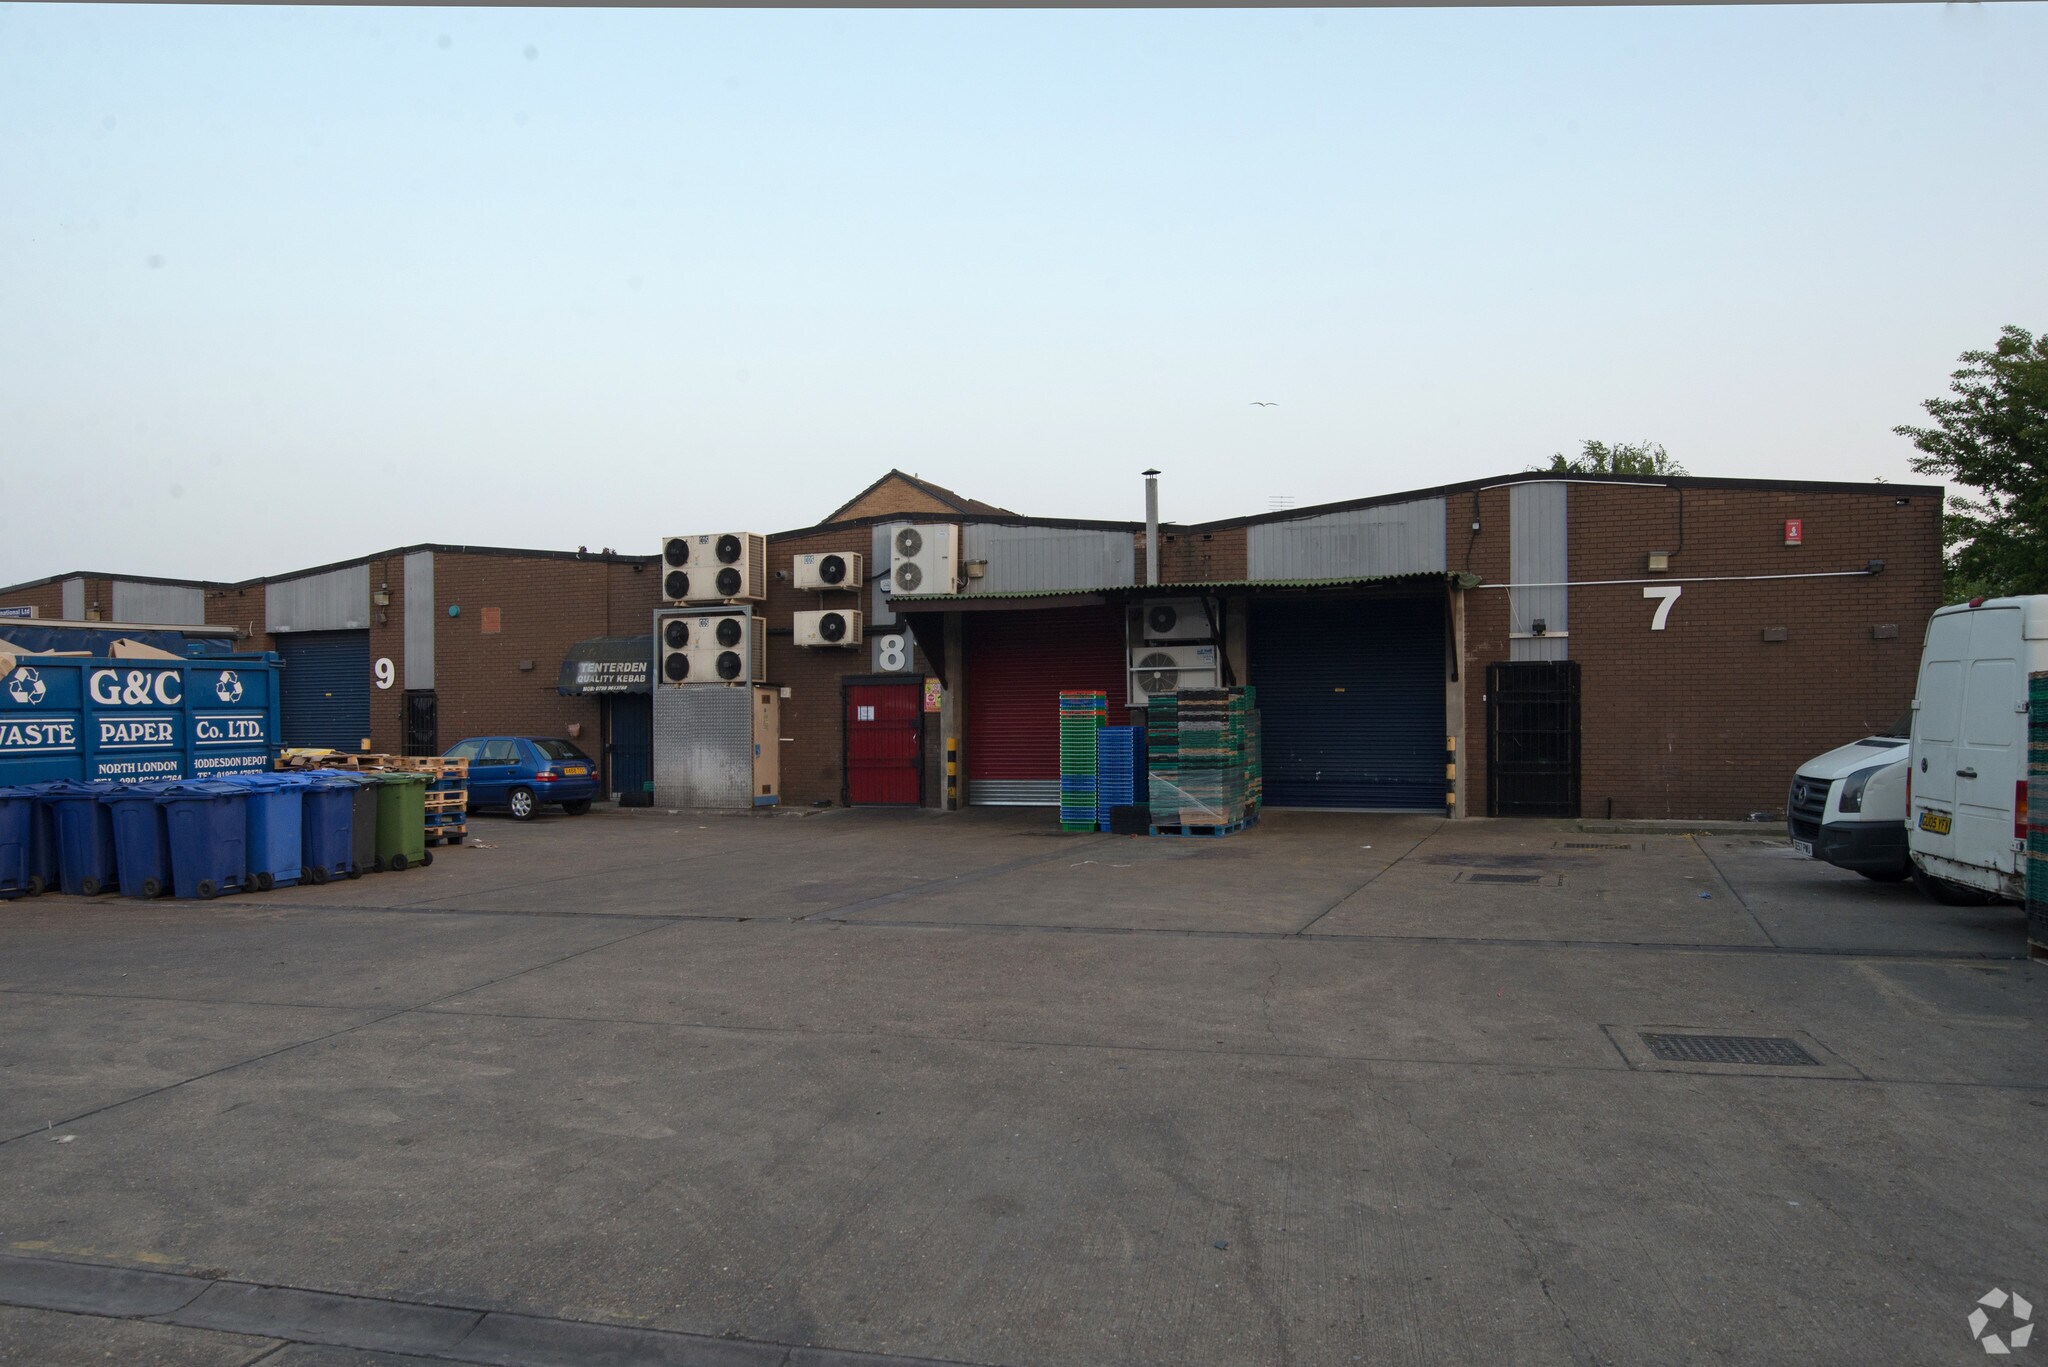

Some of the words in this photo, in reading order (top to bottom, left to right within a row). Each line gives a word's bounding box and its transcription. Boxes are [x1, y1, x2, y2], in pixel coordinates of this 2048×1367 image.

[1643, 586, 1682, 630] 7
[879, 634, 906, 671] 8
[374, 657, 395, 690] 9
[577, 674, 615, 683] QUALITY
[616, 674, 646, 683] KEBAB
[579, 661, 648, 674] TENTERDEN
[90, 669, 182, 706] G&C
[0, 723, 76, 747] ASTE
[100, 721, 173, 743] PAPER
[196, 721, 223, 739] Co.
[228, 720, 264, 738] LTD.
[98, 763, 136, 774] NORTH
[136, 760, 178, 773] LONDON
[242, 755, 267, 767] DEPOT
